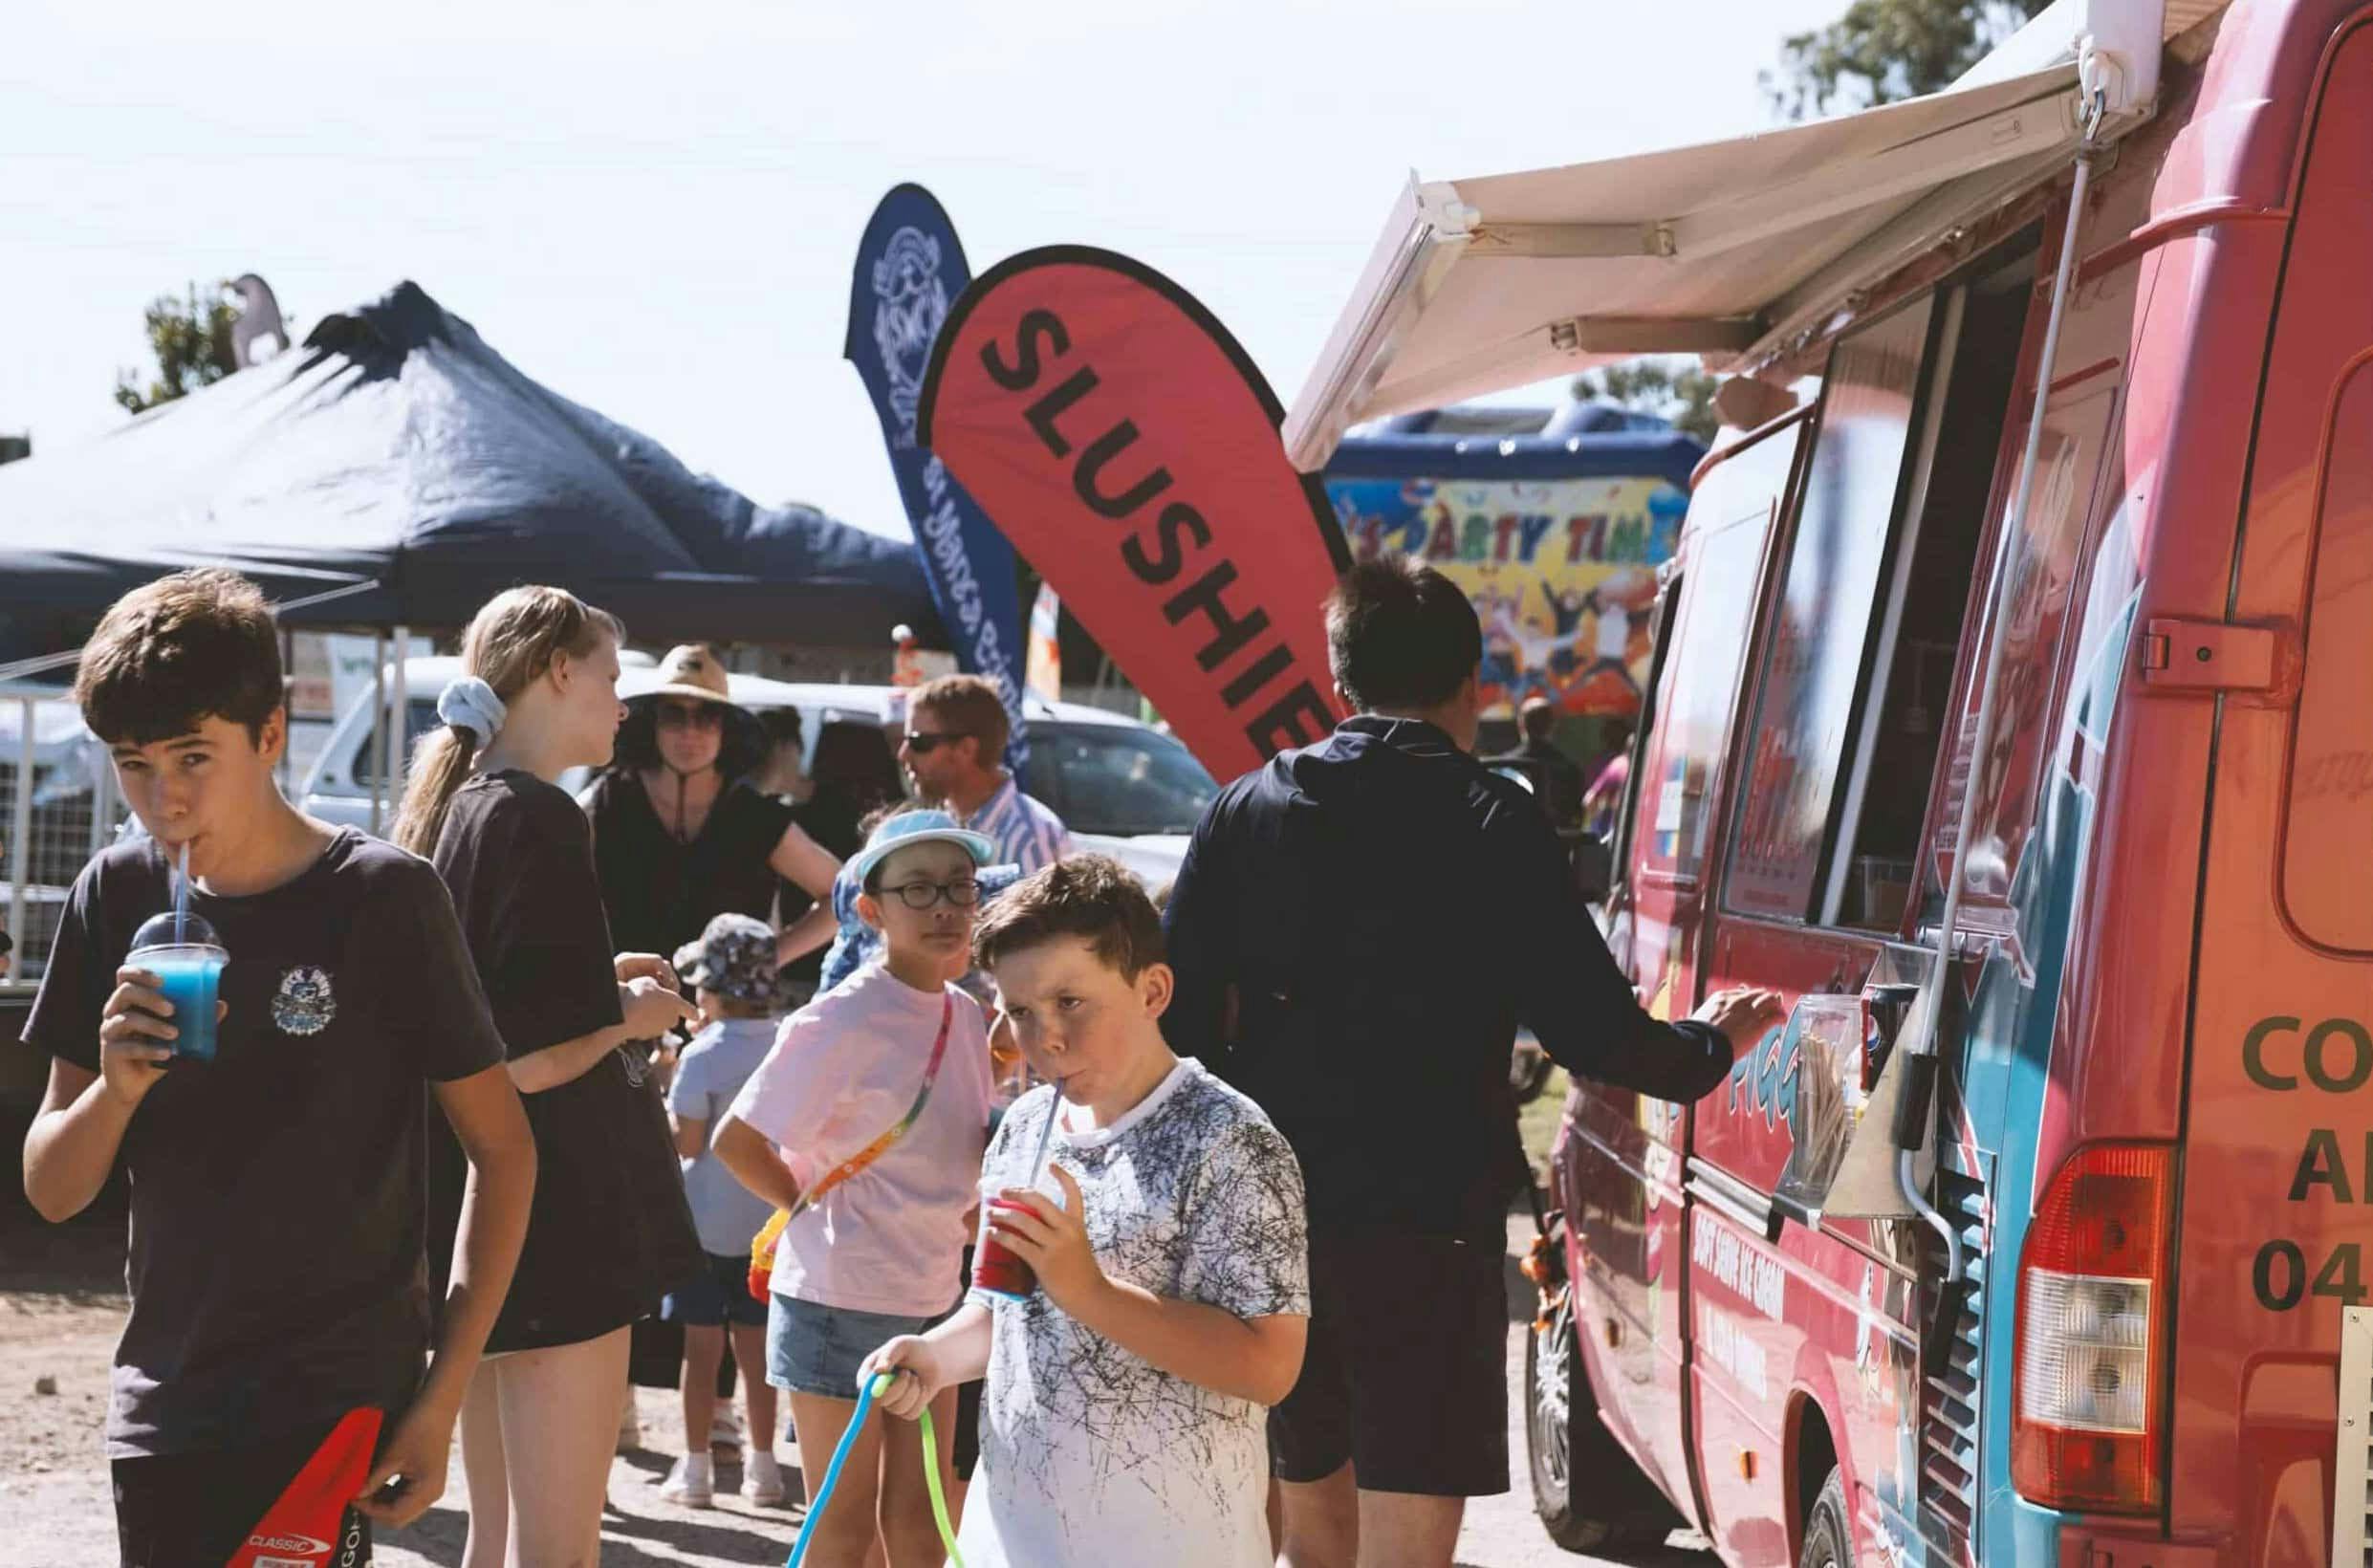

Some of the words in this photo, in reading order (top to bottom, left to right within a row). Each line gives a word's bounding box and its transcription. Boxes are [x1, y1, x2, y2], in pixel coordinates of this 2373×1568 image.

[979, 308, 1337, 761] SLUSHIE
[2287, 1128, 2373, 1204] A
[2252, 1238, 2368, 1312] 04
[249, 1534, 308, 1553] CLASSIC
